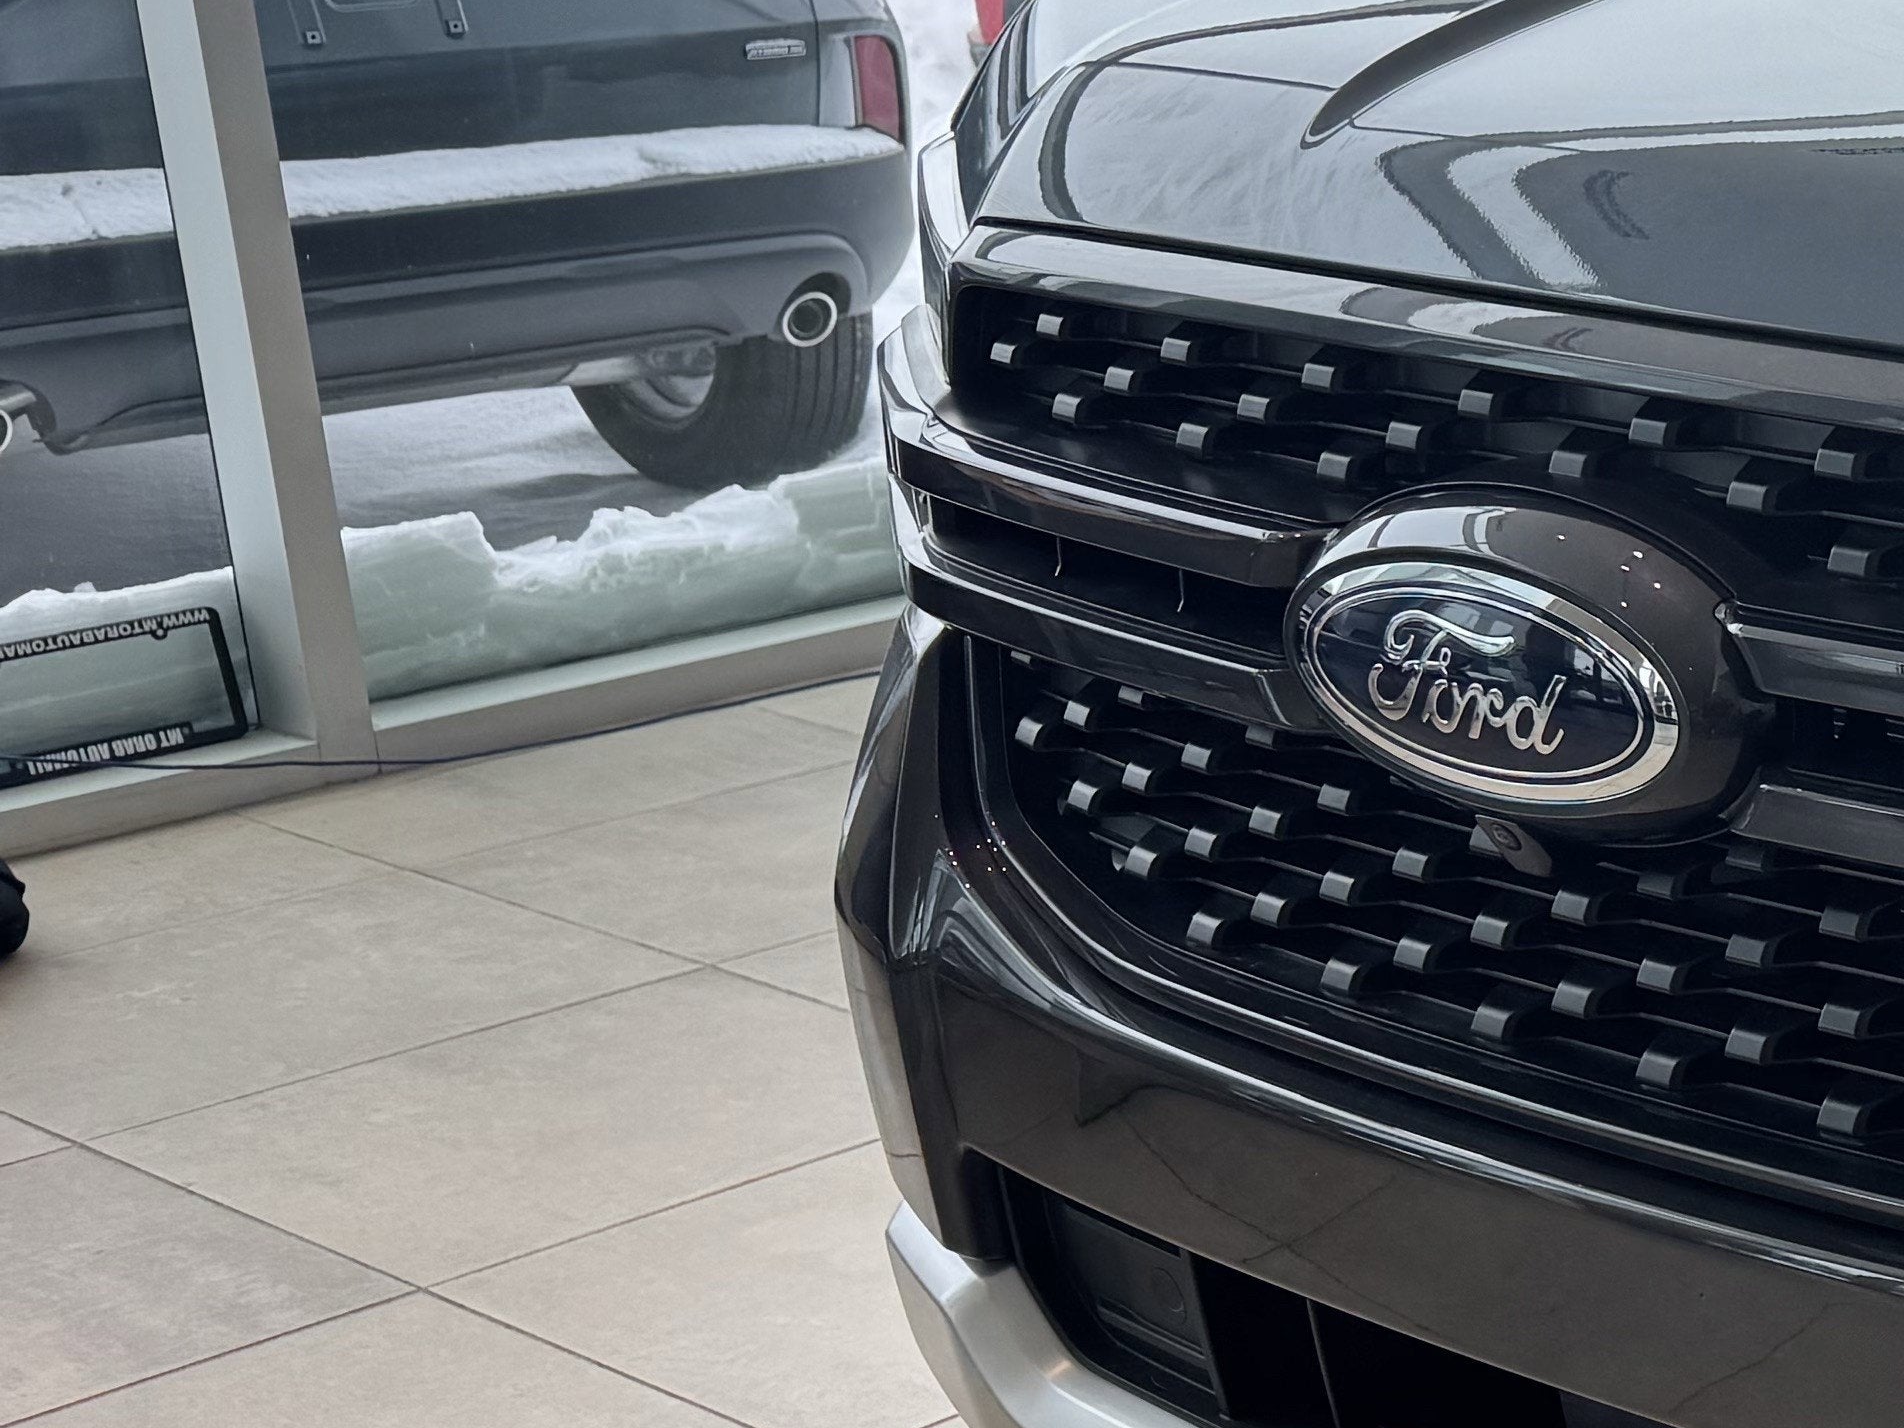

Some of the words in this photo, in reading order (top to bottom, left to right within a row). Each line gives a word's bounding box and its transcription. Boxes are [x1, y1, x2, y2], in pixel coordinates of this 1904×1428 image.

[1367, 610, 1567, 756] Ford
[111, 733, 158, 758] ORAB
[159, 727, 185, 748] MT
